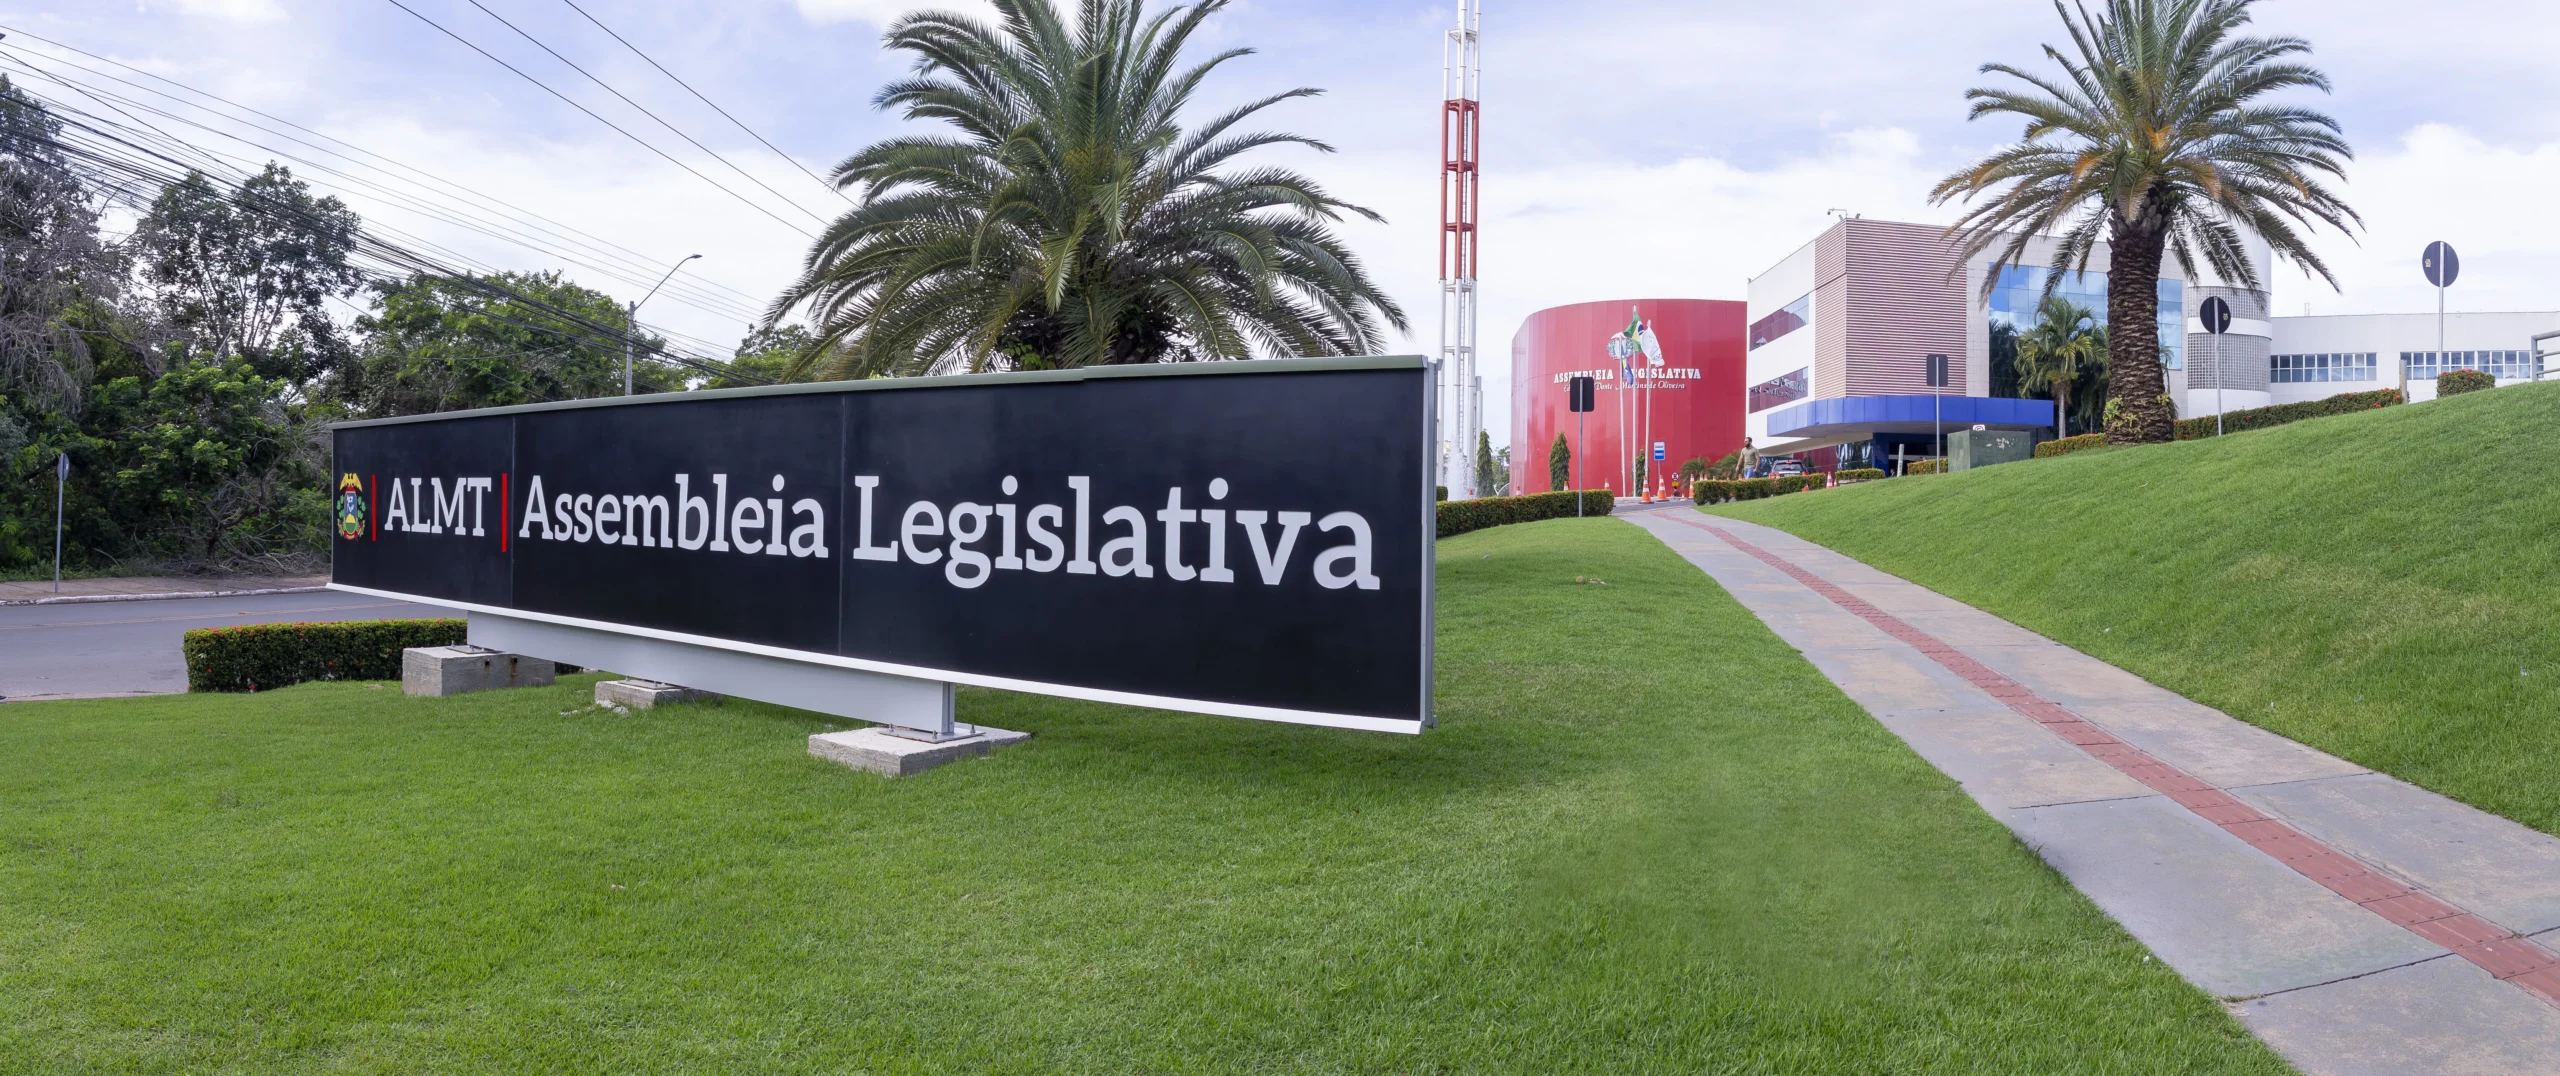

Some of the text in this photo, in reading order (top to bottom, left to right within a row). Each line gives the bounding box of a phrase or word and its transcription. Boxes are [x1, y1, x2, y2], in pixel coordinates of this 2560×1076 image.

[1624, 368, 1701, 379] EGSLATIVA
[1658, 380, 1685, 389] Oliveira
[384, 473, 1381, 589] ALMT Assembleia Legislativa
